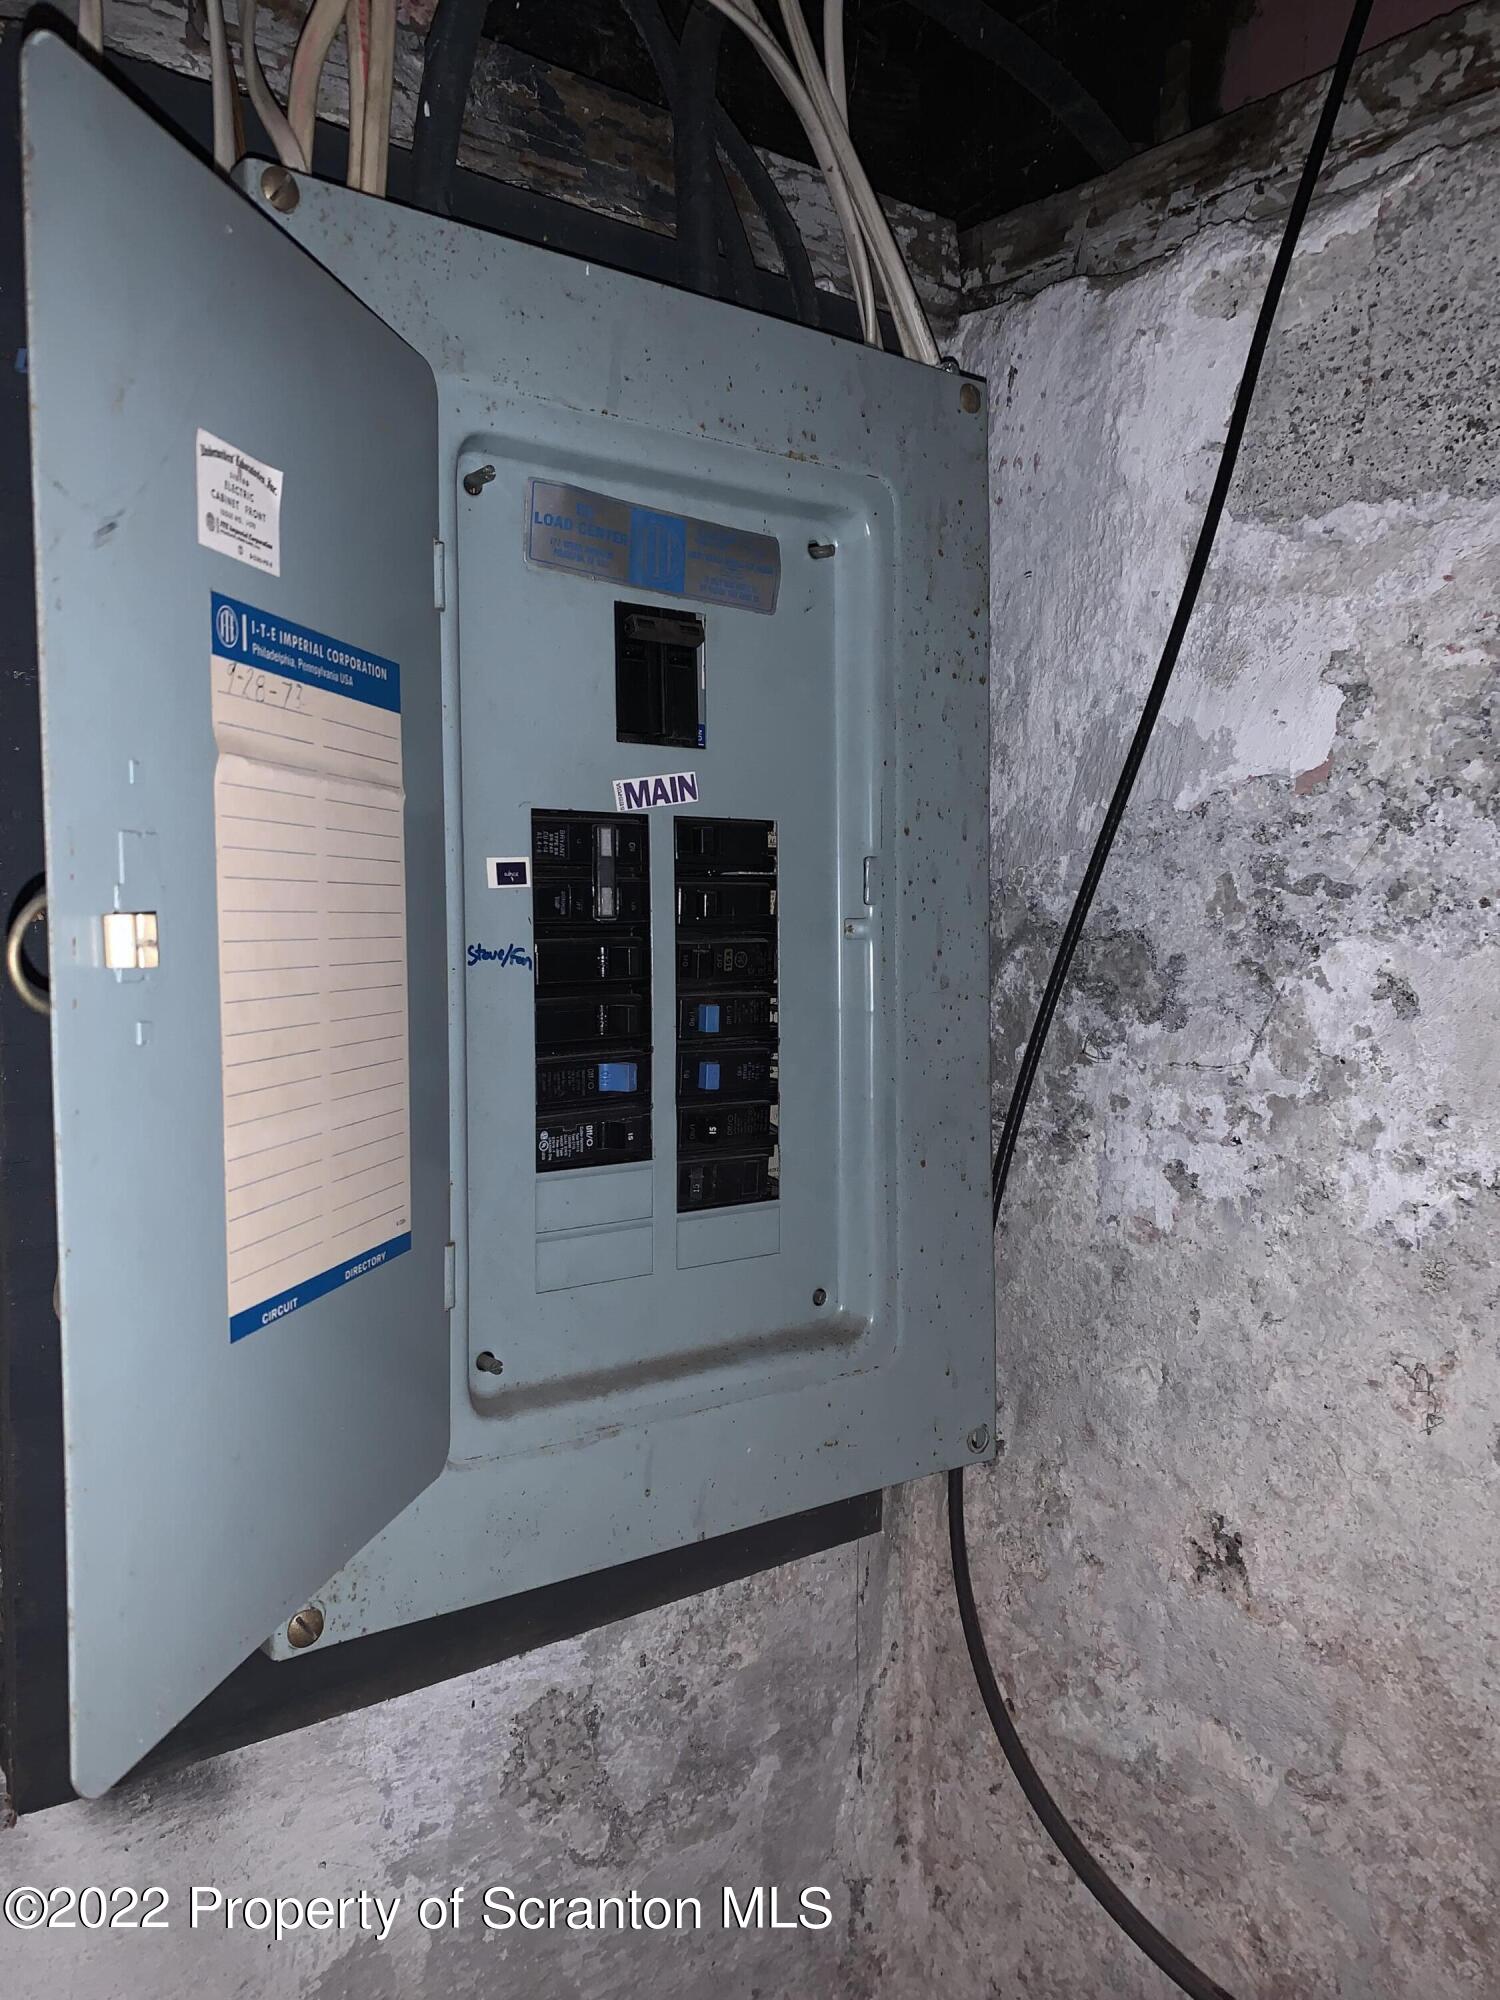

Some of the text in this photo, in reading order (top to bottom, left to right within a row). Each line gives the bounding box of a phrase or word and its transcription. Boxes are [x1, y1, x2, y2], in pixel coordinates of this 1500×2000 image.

[534, 511, 573, 531] LOAD
[251, 620, 388, 681] I-T-E IMPERIAL CORPORATION
[252, 642, 354, 687] Philadelphia, Pennsylvania USA
[623, 773, 698, 810] MAIN
[708, 1126, 717, 1135] 15
[262, 1251, 387, 1324] CIRCUIT DIRECTORY
